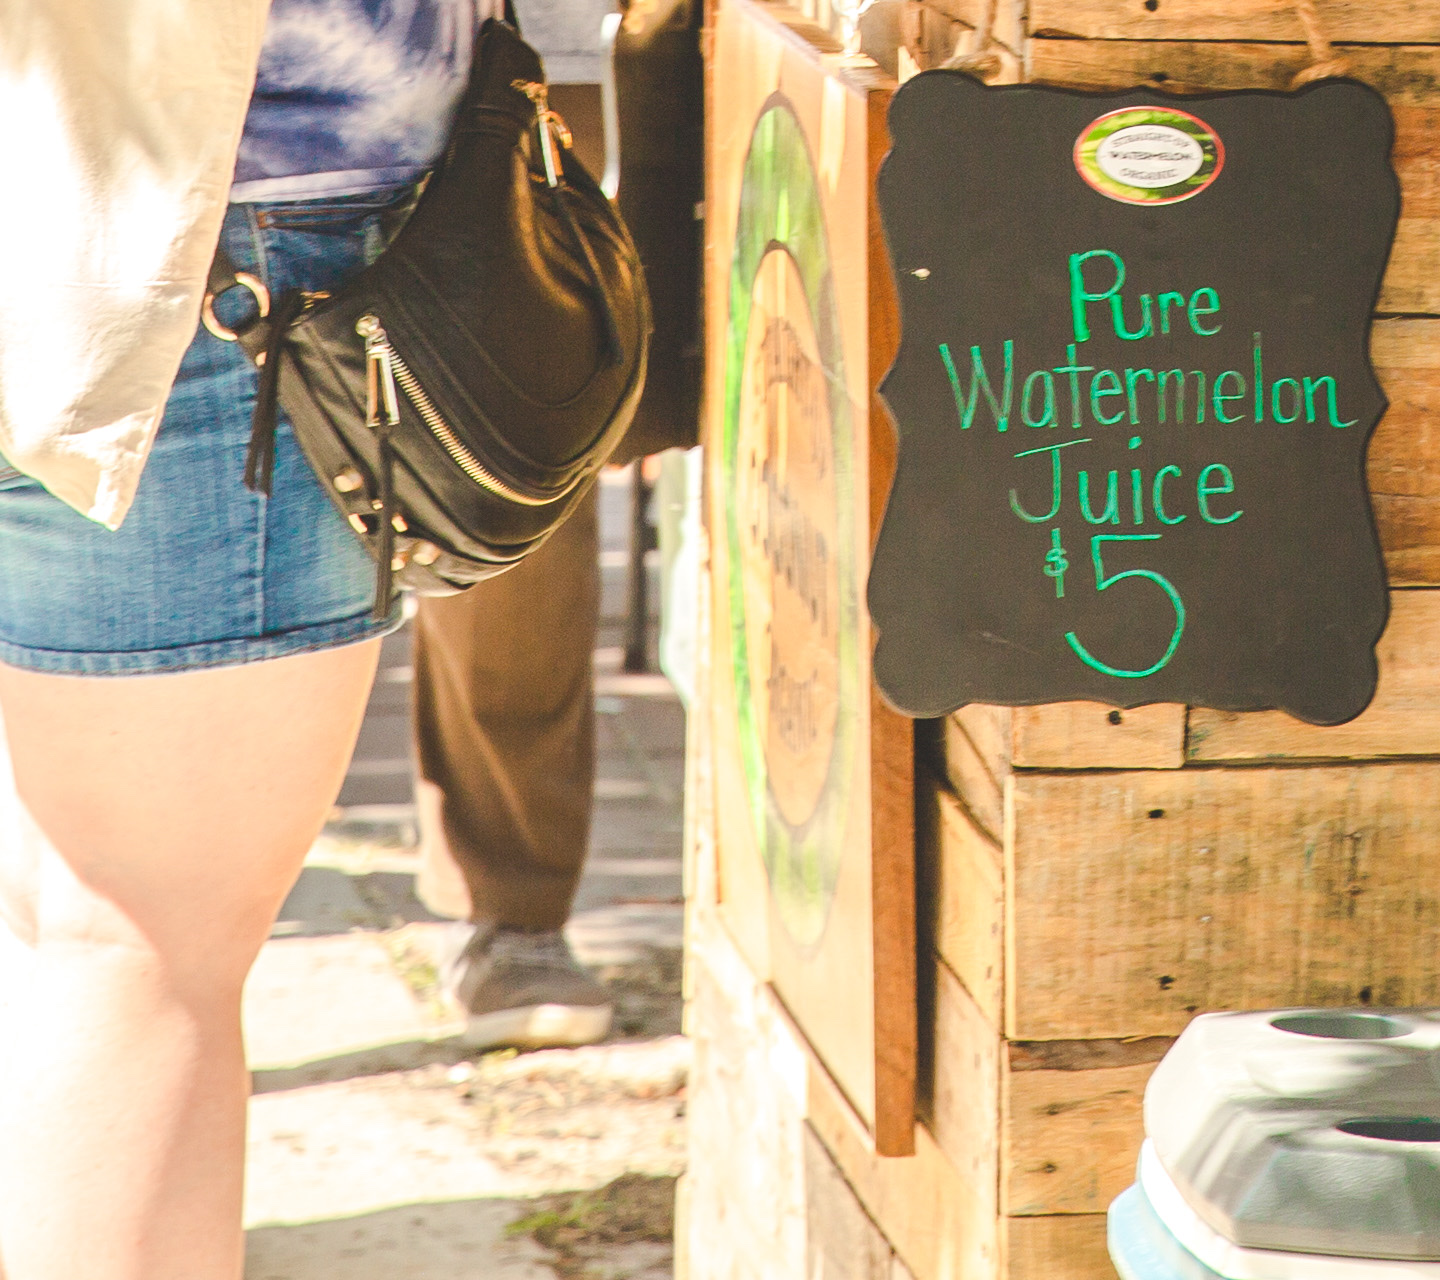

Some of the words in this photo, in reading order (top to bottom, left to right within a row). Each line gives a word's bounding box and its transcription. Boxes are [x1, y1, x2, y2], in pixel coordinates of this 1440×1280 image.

[1068, 248, 1222, 342] Pure
[938, 331, 1358, 432] Watermelon
[1009, 435, 1245, 526] Juice
[1043, 527, 1186, 679] $5
